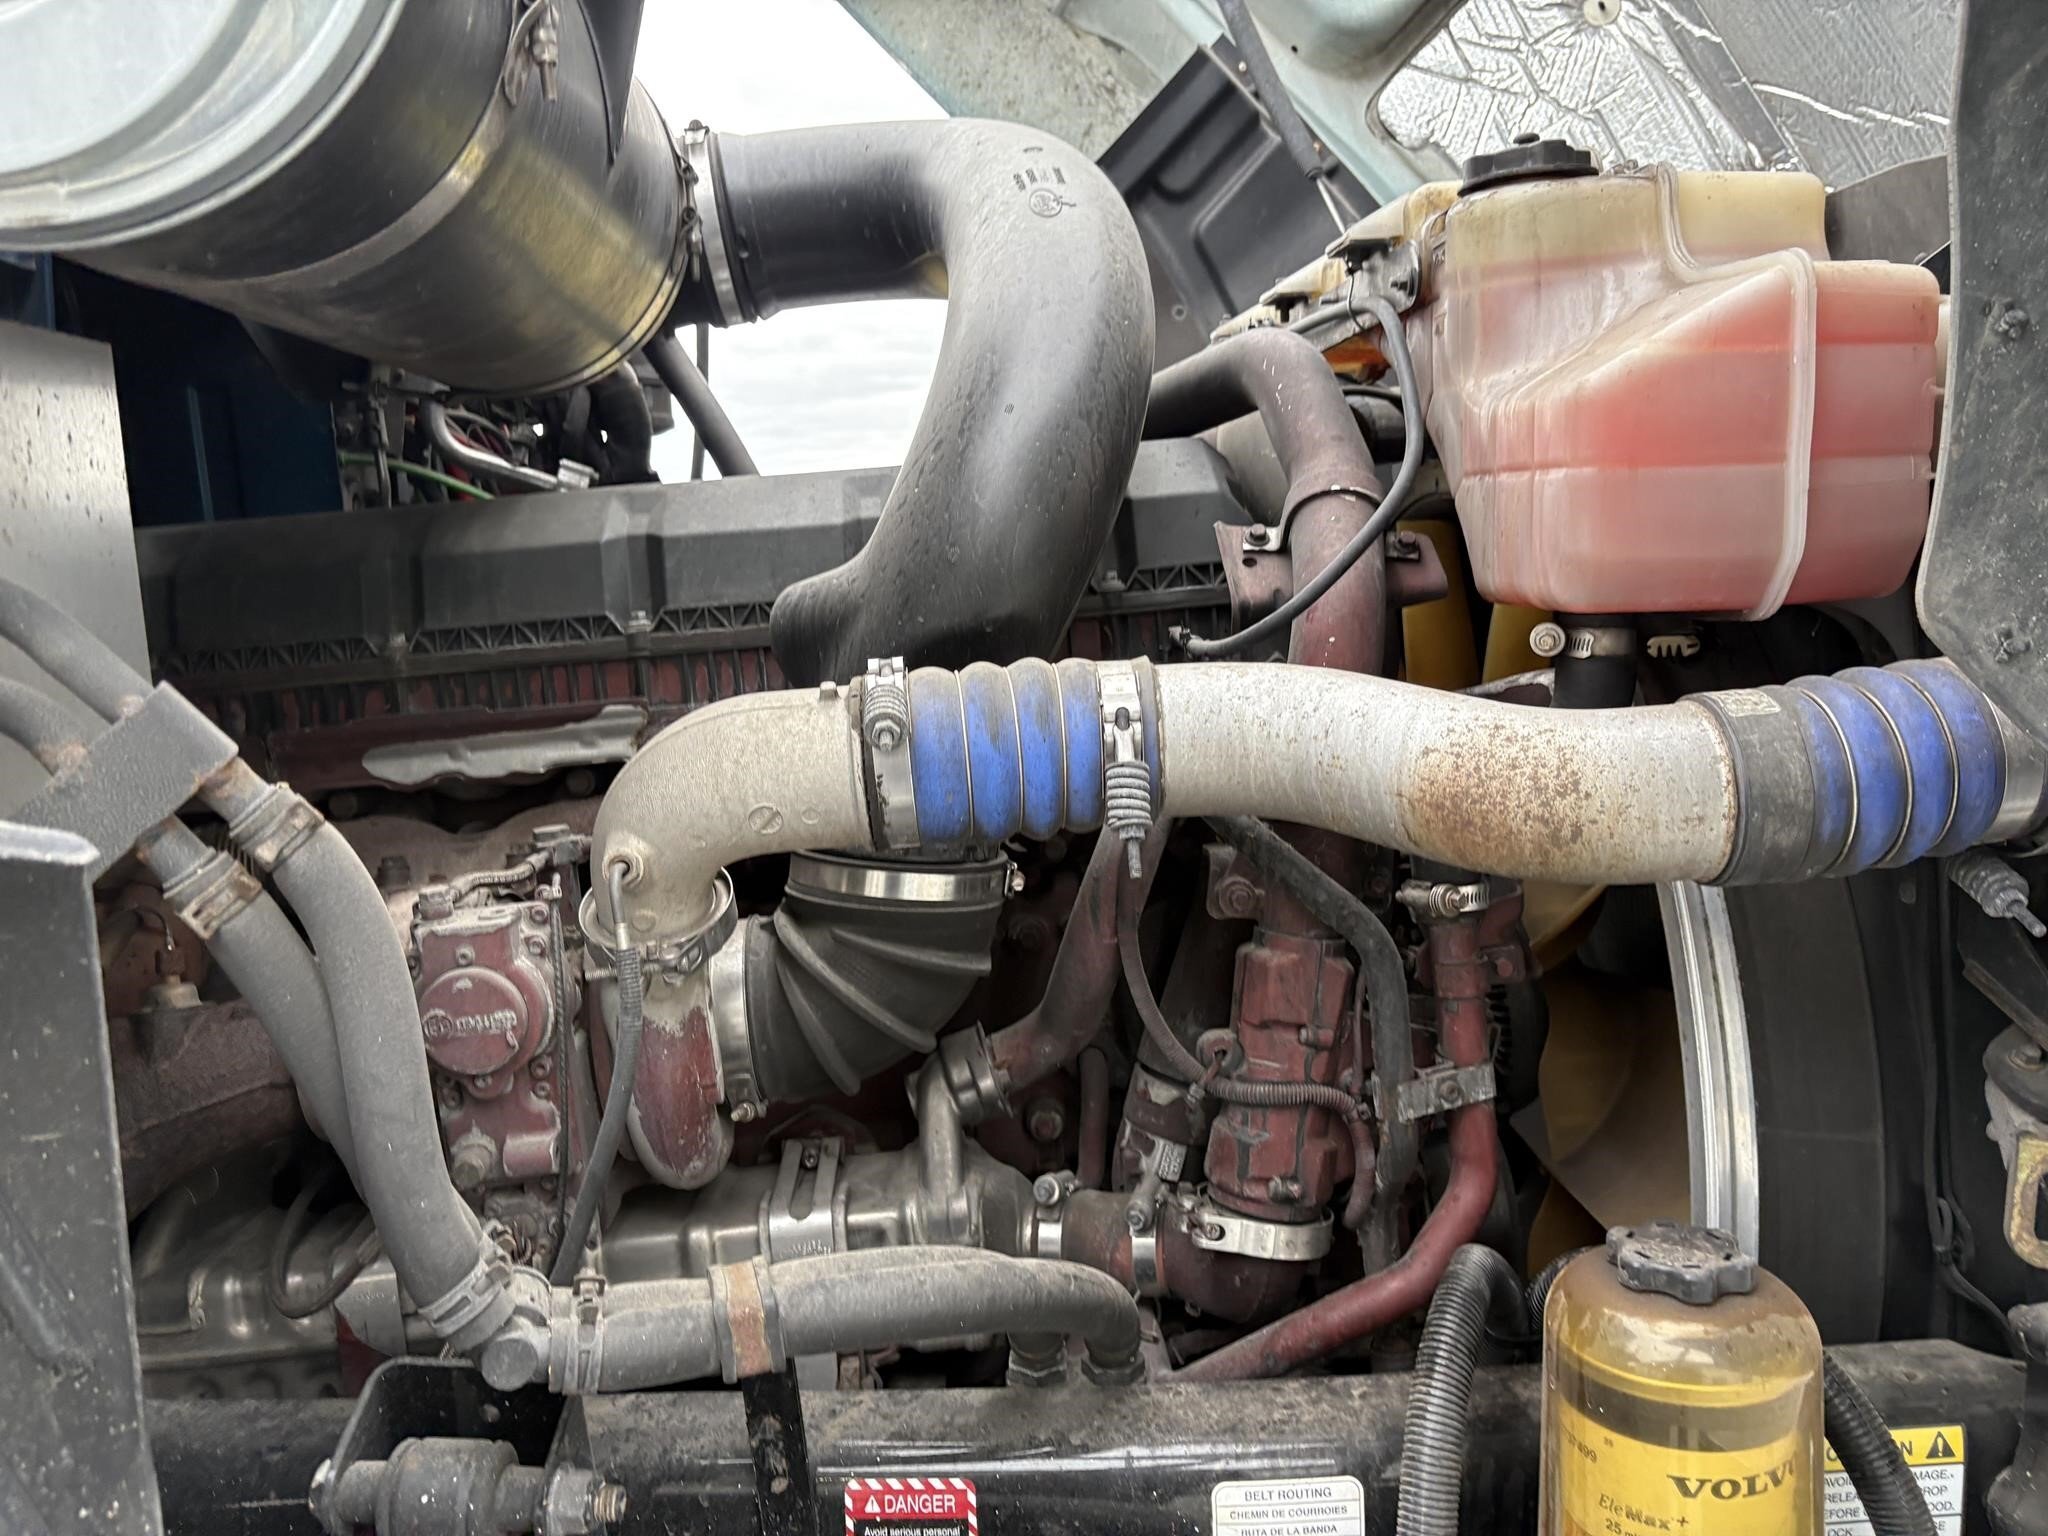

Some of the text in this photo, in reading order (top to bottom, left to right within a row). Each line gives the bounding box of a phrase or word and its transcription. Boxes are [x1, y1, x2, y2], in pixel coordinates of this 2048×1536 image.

[1244, 1487, 1332, 1502] BELT ROUTING
[884, 1494, 956, 1514] DANGER
[1229, 1505, 1348, 1520] CHEMIN DE COURROIES
[1270, 1527, 1284, 1536] DE
[1286, 1526, 1300, 1536] LA
[1302, 1524, 1337, 1536] BANDA
[1605, 1518, 1622, 1535] 25
